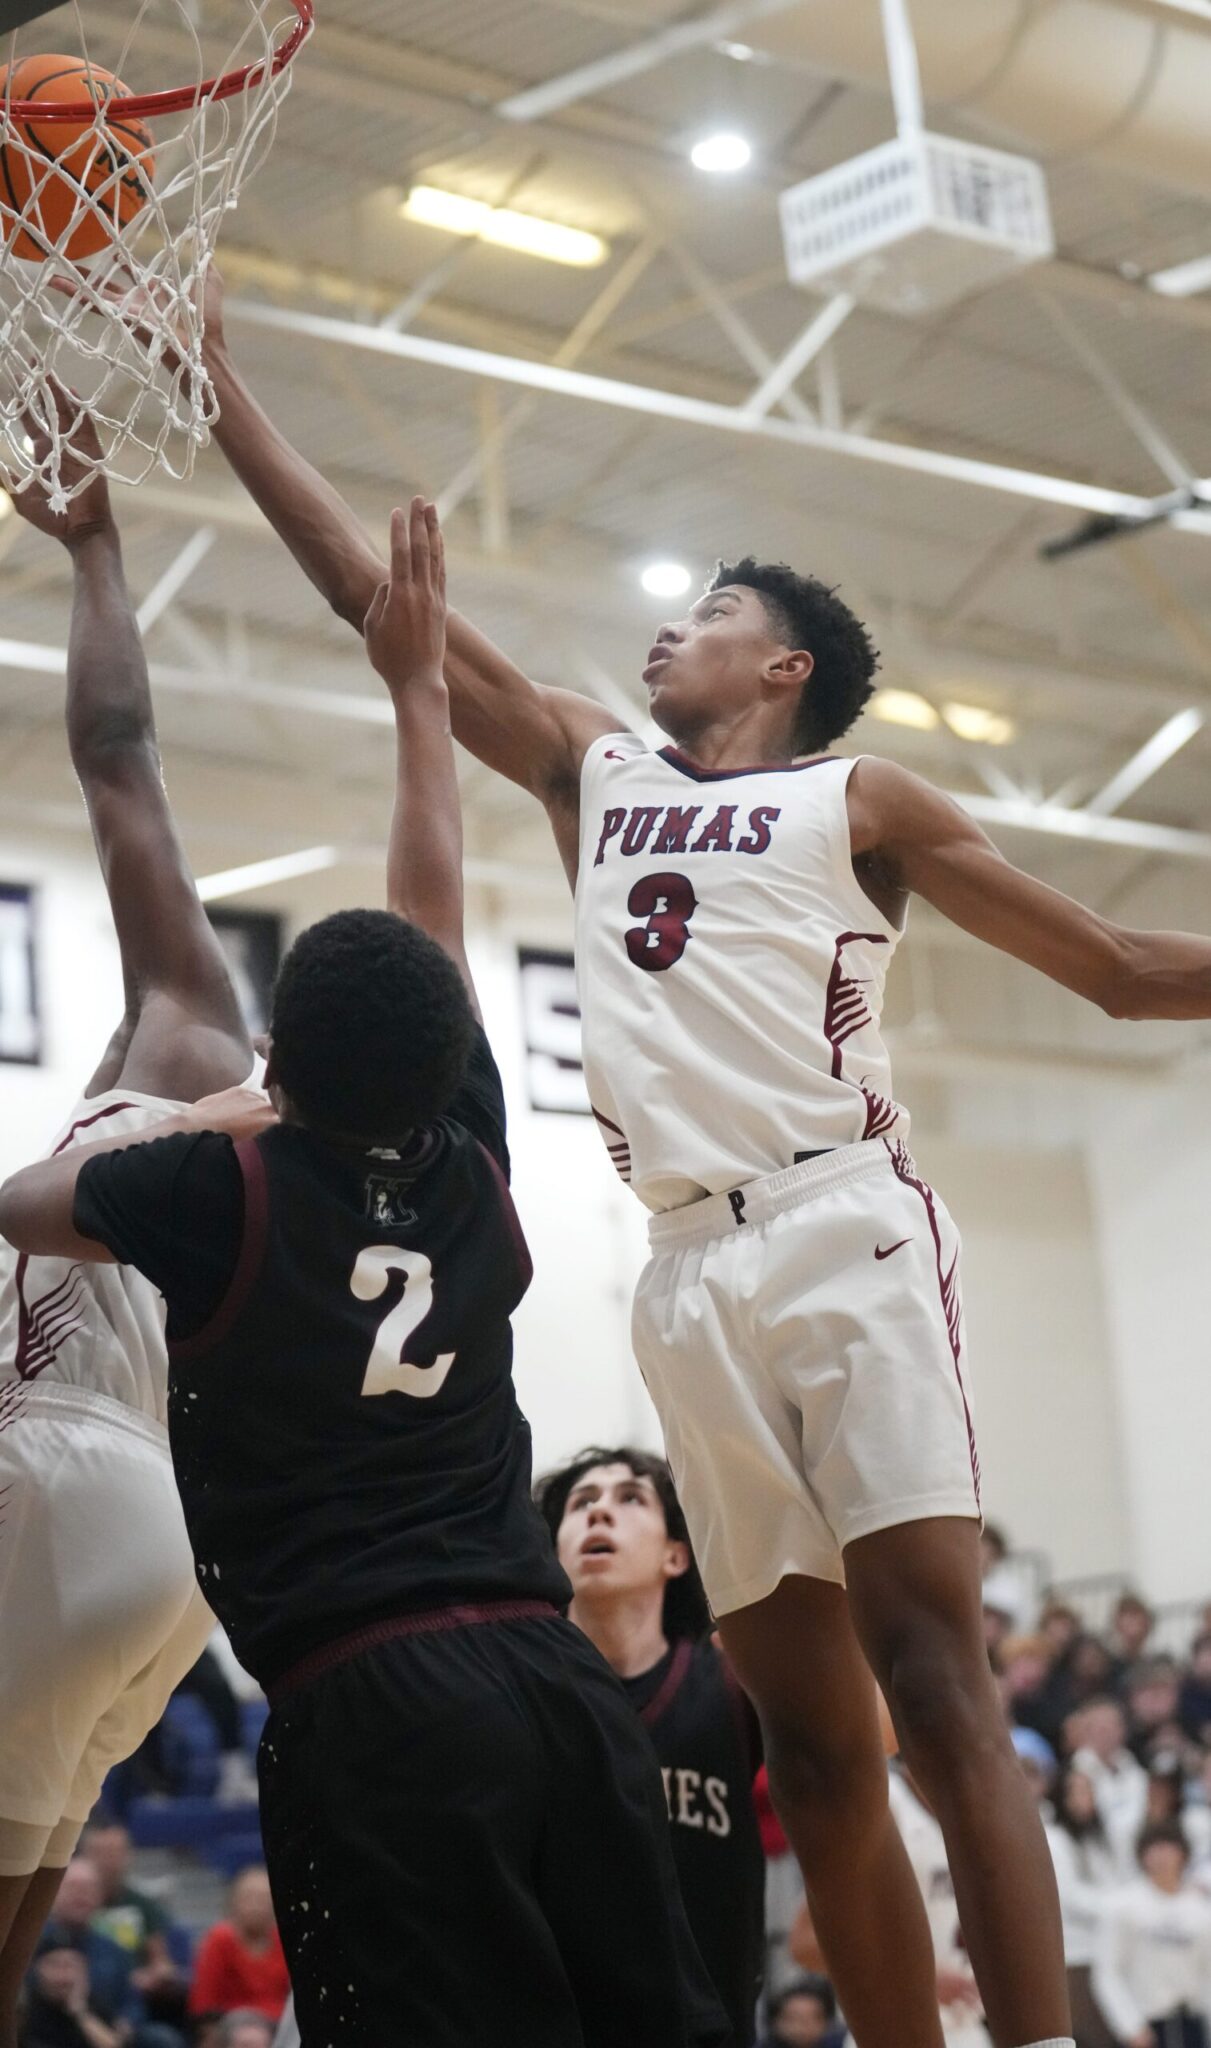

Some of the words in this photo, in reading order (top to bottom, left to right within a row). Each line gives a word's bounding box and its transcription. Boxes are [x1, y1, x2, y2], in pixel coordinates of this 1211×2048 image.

[594, 805, 781, 868] PUMAS
[624, 872, 699, 972] 3
[728, 1189, 747, 1226] P
[350, 1245, 456, 1398] 2
